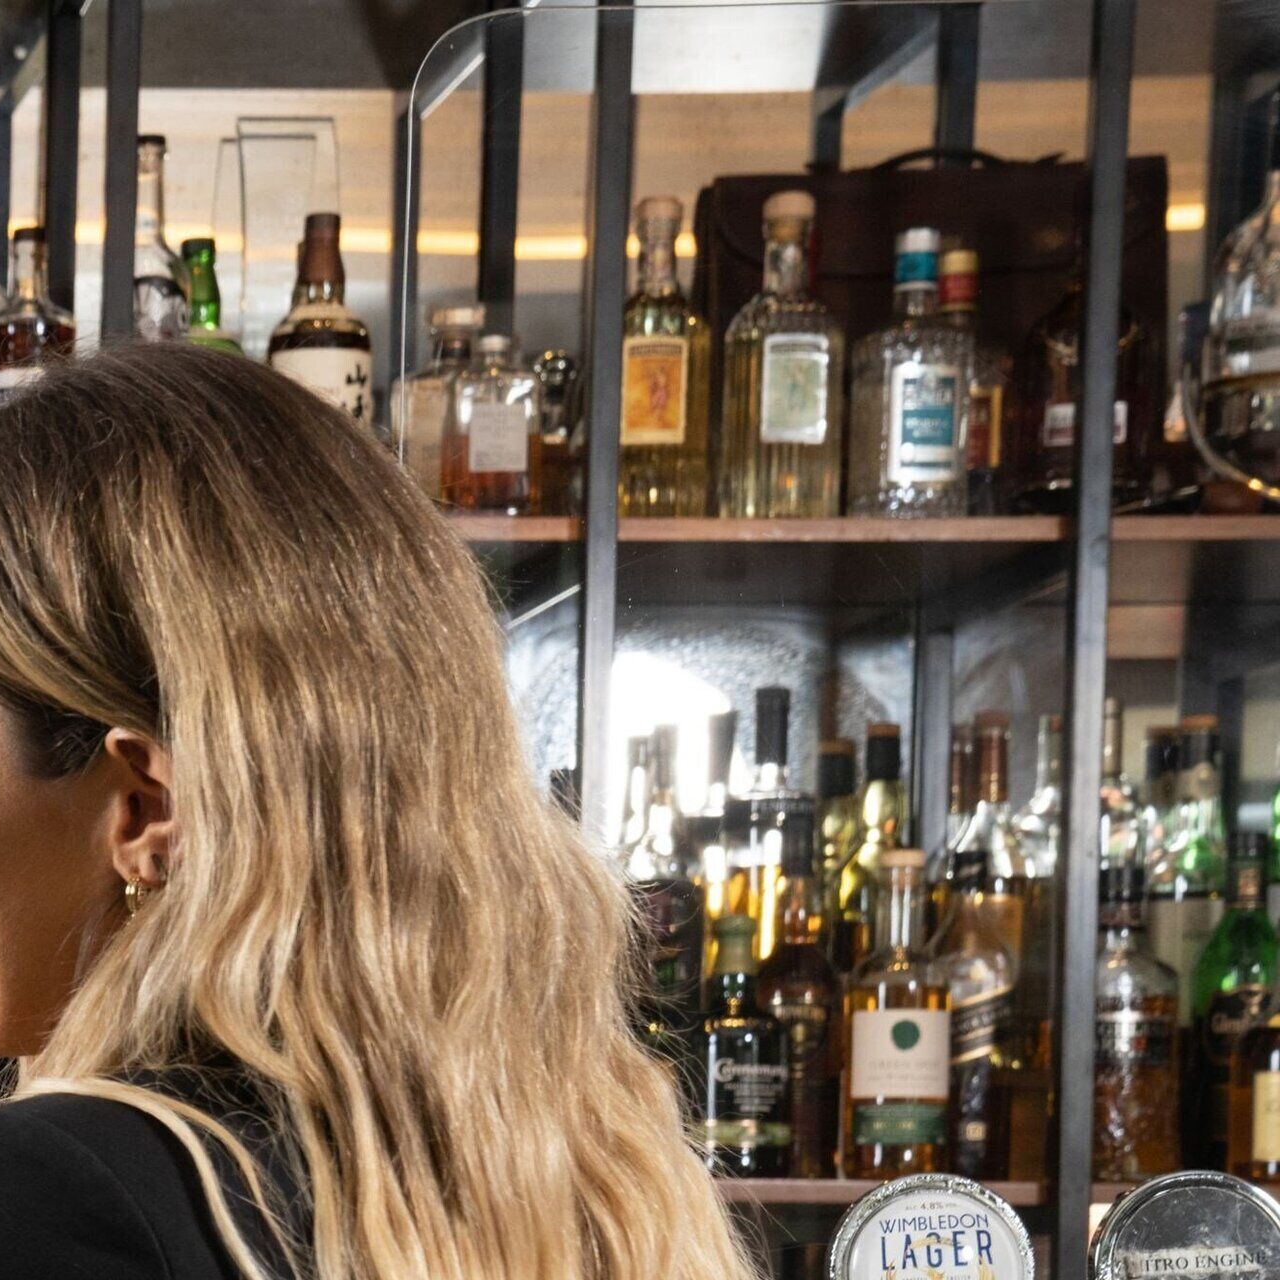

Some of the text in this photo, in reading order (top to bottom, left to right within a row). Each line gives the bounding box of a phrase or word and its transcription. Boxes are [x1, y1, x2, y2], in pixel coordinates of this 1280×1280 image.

[920, 1201, 944, 1211] 4.8%
[879, 1213, 990, 1235] WIMBLEDON
[880, 1229, 994, 1272] LAGER
[1194, 1251, 1268, 1270] ENGINE
